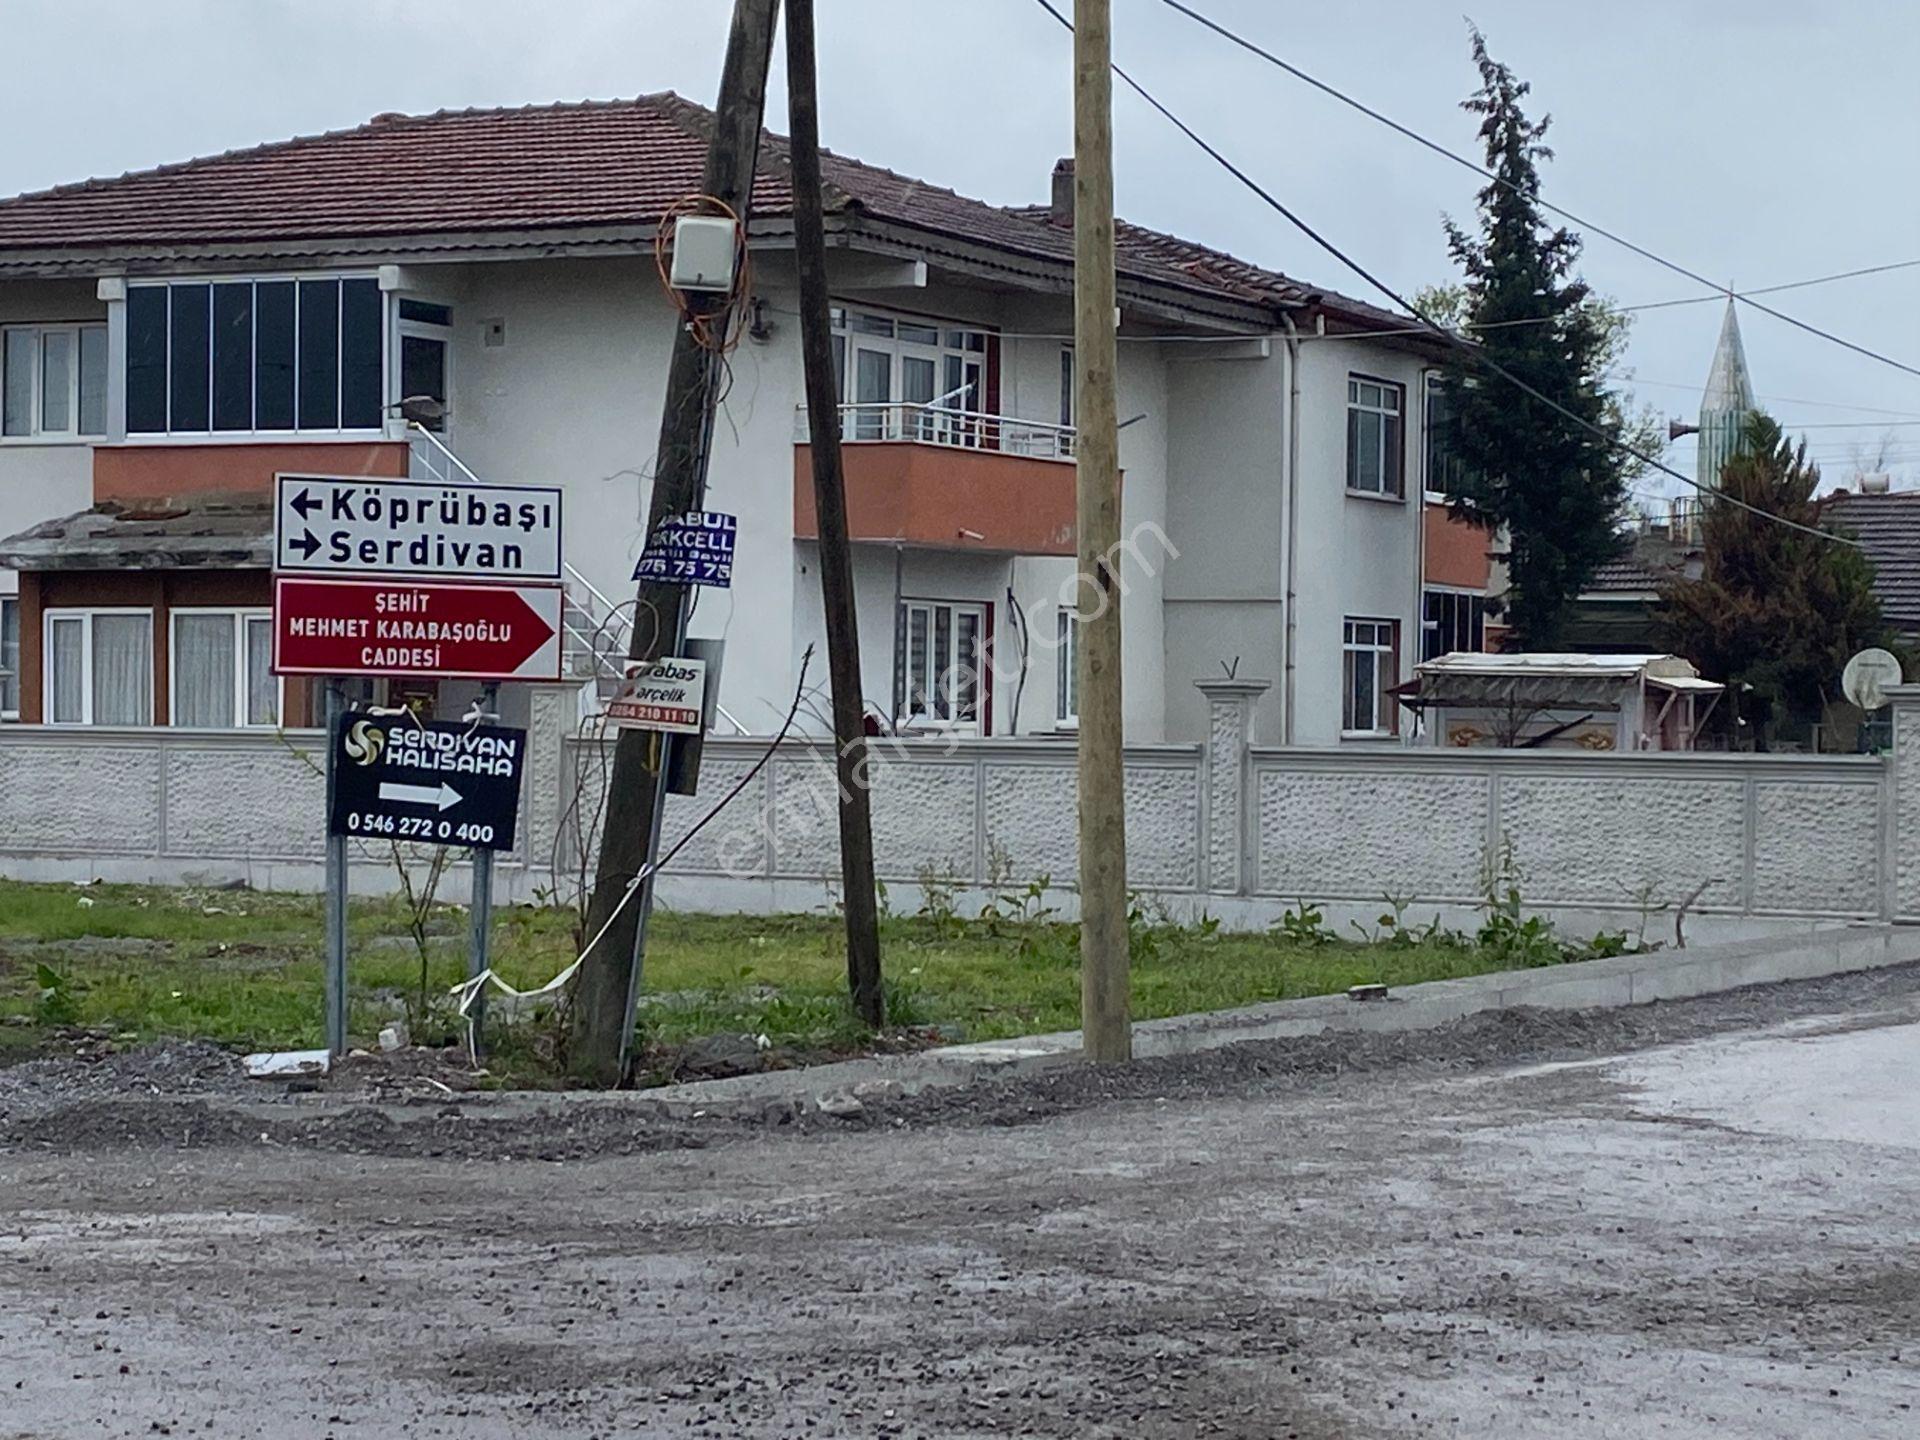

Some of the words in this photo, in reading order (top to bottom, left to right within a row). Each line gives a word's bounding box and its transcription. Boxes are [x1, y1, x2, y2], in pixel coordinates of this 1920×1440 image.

[331, 488, 551, 532] Köprübaşı
[328, 530, 522, 568] Serdivan
[375, 589, 430, 612] ŞEHİT
[289, 618, 370, 639] MEHMET
[376, 619, 512, 643] KARABAŞOĞLU
[361, 643, 441, 668] CADDESİ
[385, 747, 513, 777] HALISAHA
[348, 812, 360, 830] 0
[363, 813, 395, 833] 546
[398, 817, 433, 837] 272
[438, 821, 451, 838] 0
[456, 823, 494, 843] 400
